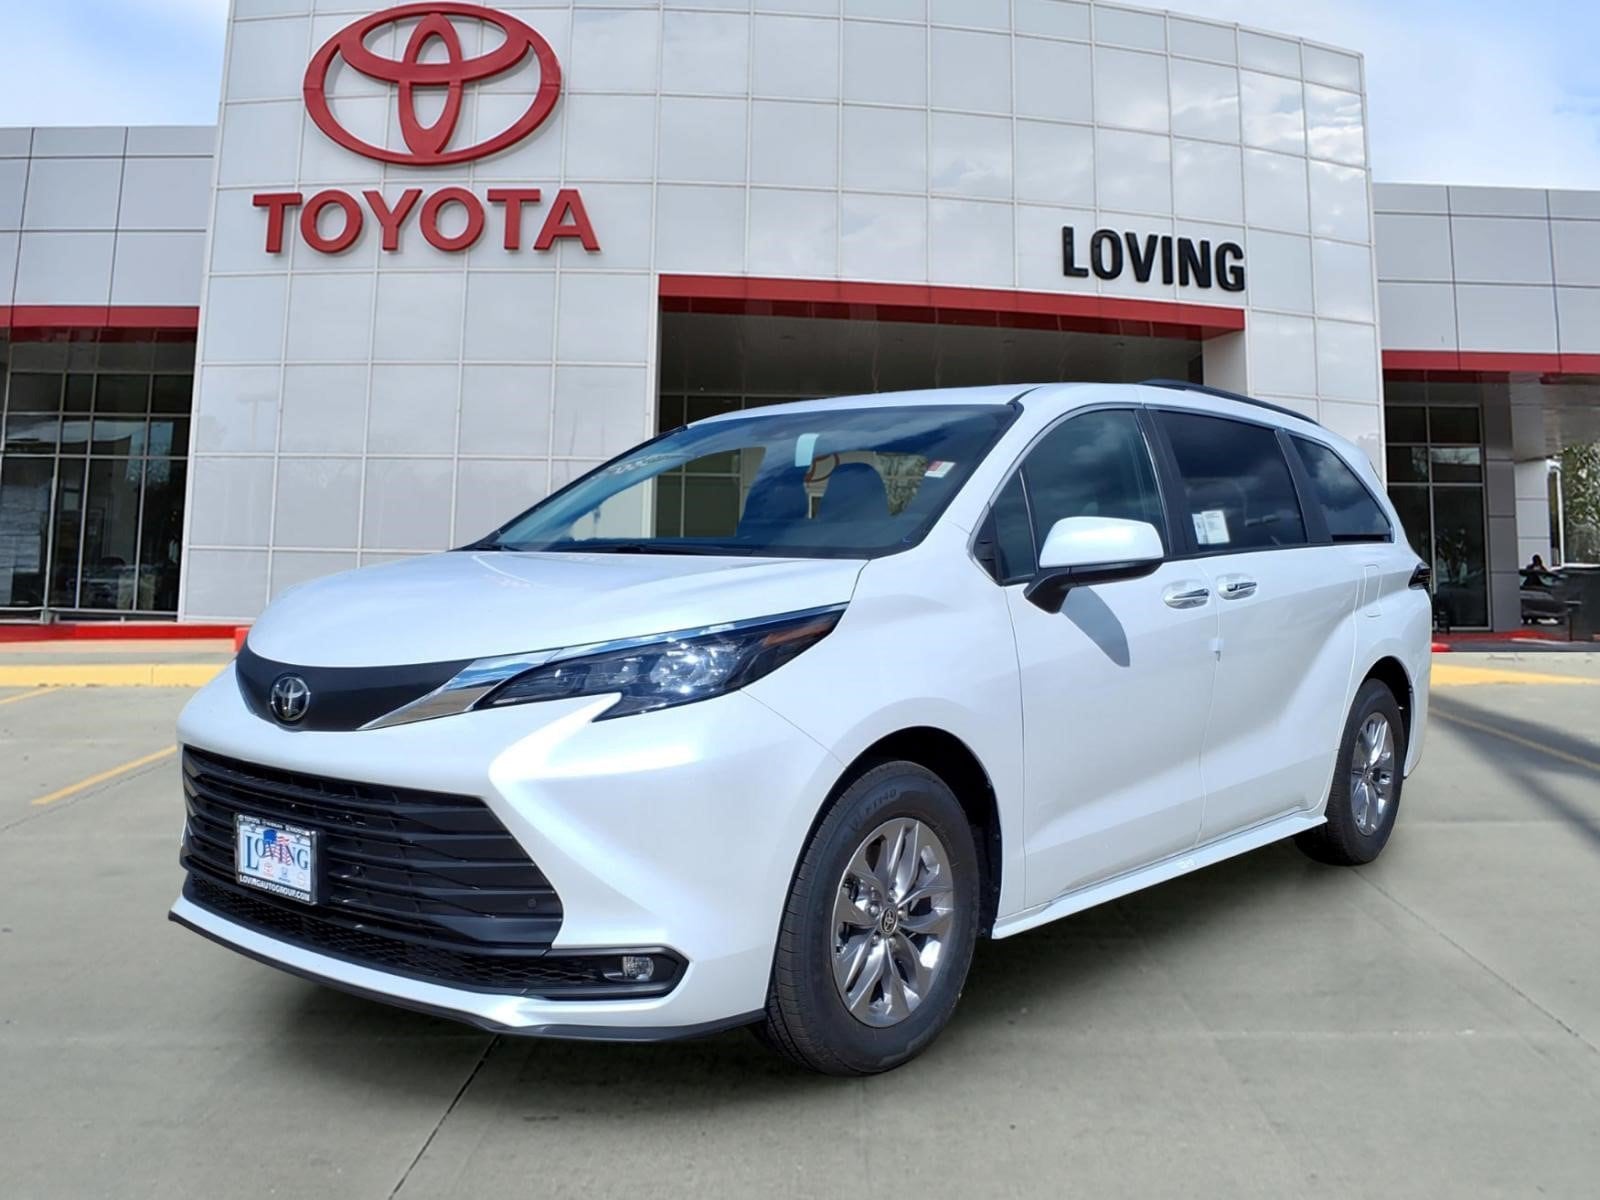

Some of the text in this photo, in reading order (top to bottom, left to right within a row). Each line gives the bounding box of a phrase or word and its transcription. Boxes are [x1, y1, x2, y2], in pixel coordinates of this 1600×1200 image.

[253, 186, 600, 253] TOYOTA
[1062, 226, 1245, 292] LOVING
[245, 835, 309, 871] LOVING
